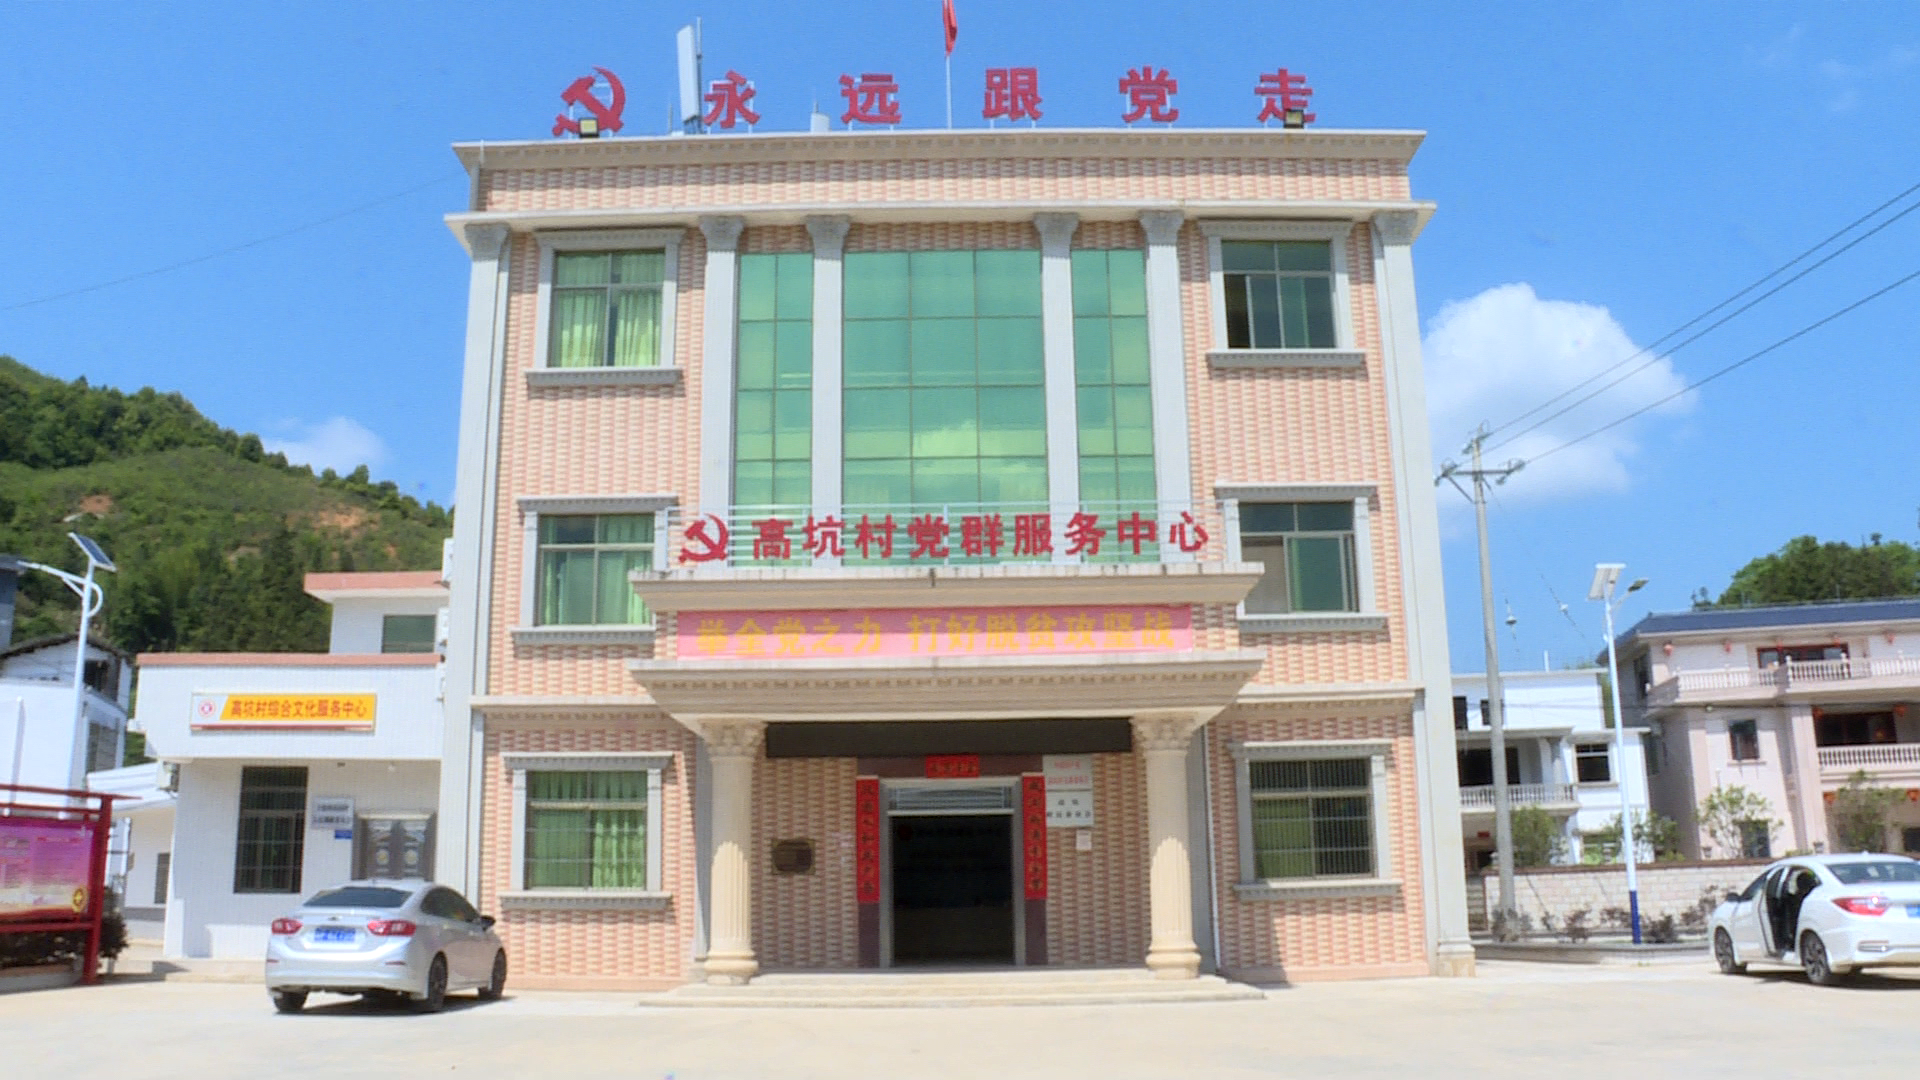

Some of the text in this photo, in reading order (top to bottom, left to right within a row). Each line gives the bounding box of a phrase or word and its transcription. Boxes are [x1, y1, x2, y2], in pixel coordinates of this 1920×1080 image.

[704, 66, 1316, 128] 永远跟党走
[751, 511, 1208, 560] 高坑村党群服务中心
[695, 611, 1175, 656] 举全党之力 打好脱贫攻坚战
